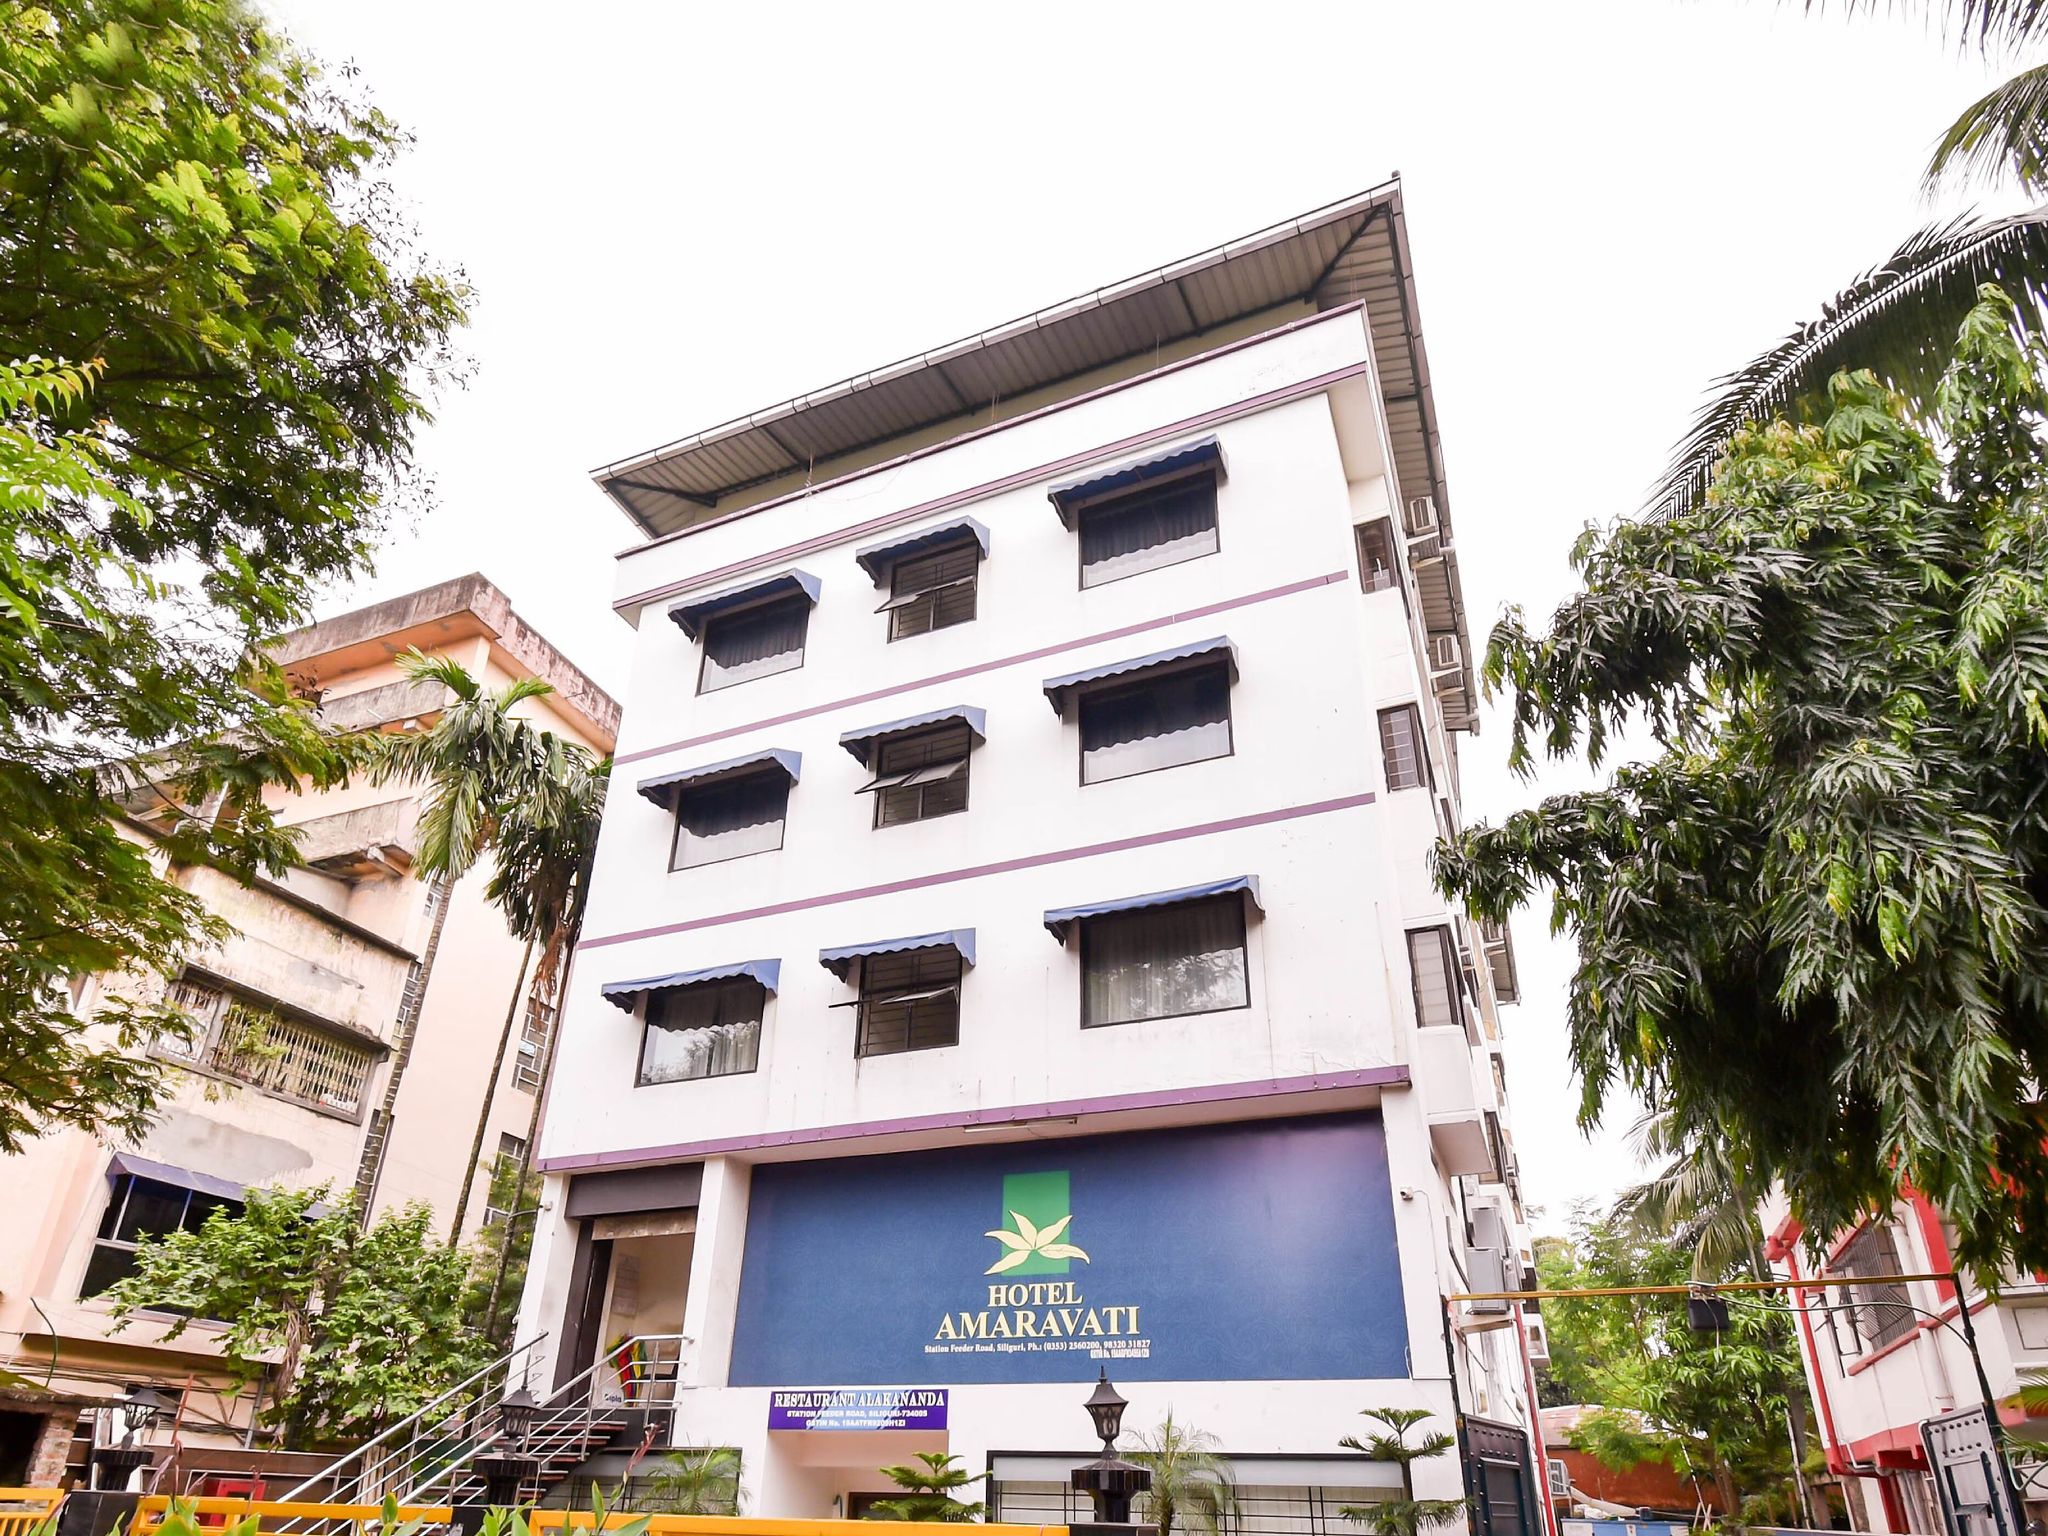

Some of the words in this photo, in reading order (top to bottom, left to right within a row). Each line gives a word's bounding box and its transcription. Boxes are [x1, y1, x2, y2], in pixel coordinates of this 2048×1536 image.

[987, 1281, 1083, 1308] HOTEL
[934, 1306, 1141, 1340] AMARAVATI
[924, 1344, 949, 1353] Station
[950, 1343, 974, 1353] Feeder
[975, 1343, 996, 1353] Road,
[997, 1342, 1026, 1354] Siliguri,
[1043, 1341, 1067, 1352] (0353)
[1103, 1340, 1126, 1349] 98320
[774, 1392, 856, 1408] RESTAURANT
[858, 1391, 945, 1407] ALAKANANDA
[786, 1410, 816, 1418] STATION
